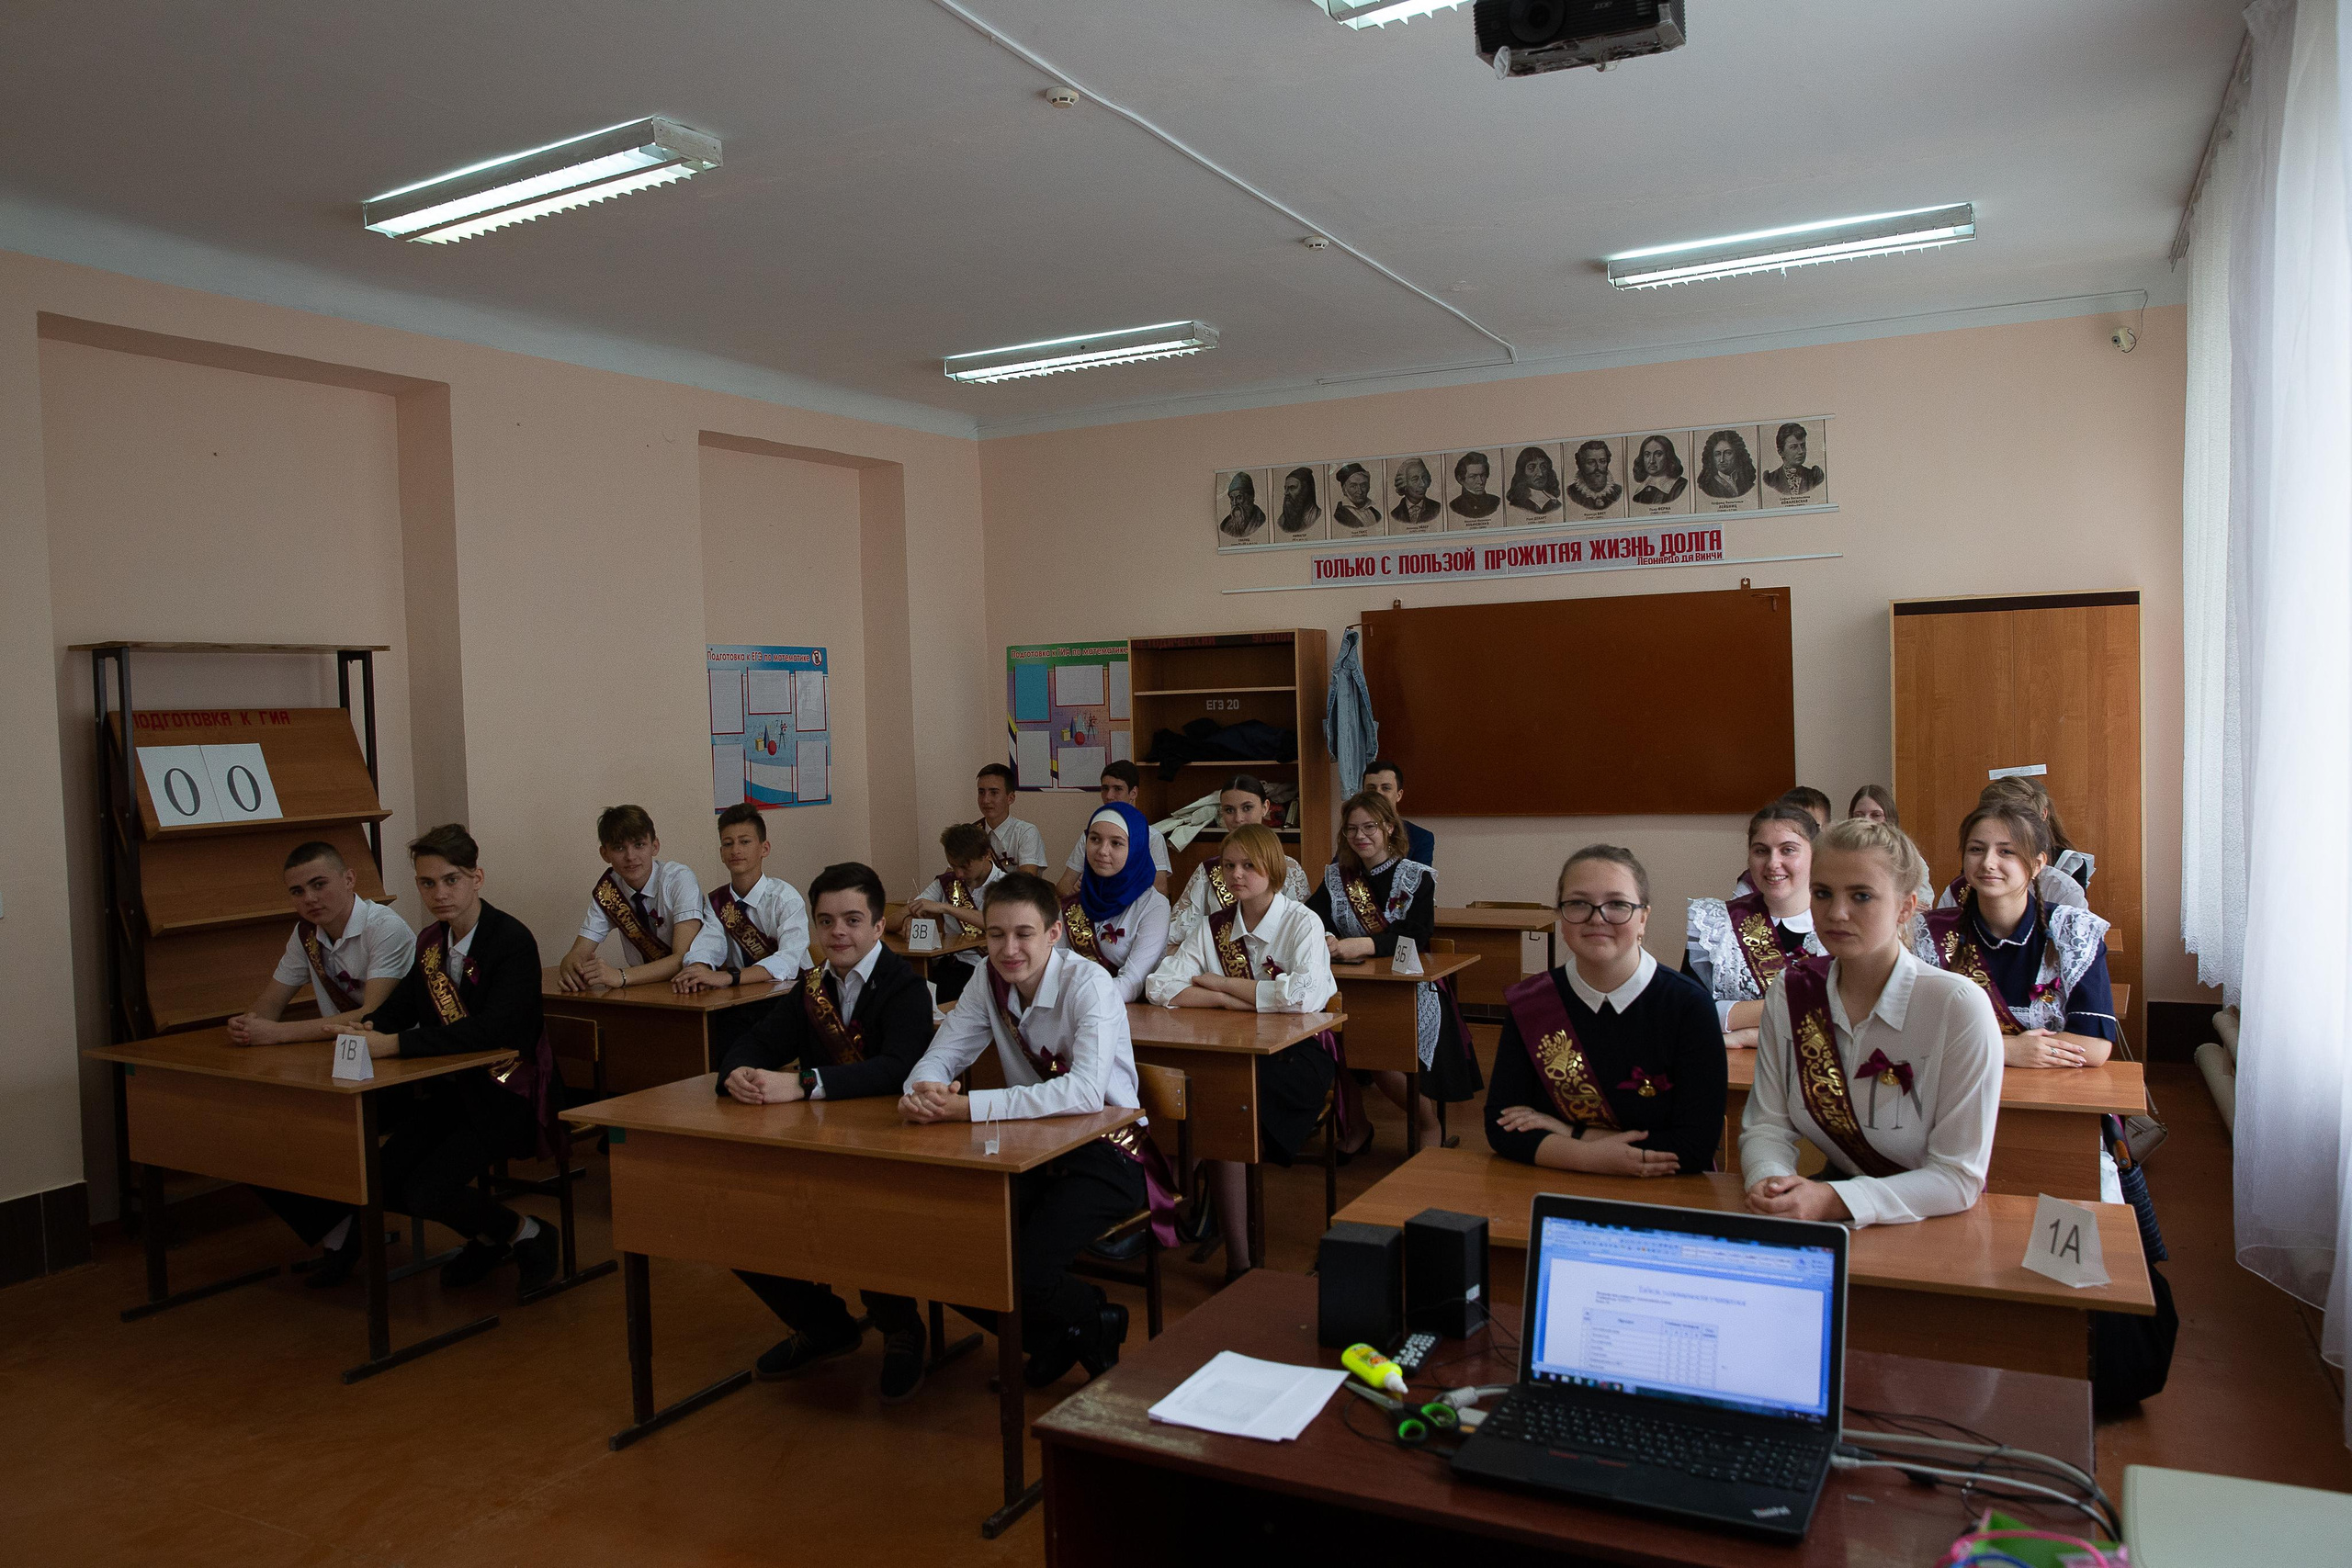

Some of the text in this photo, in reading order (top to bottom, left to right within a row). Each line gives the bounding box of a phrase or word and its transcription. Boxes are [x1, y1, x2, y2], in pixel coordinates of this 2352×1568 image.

[1314, 530, 1722, 579] ТОЛЬКО С ПОЛЬЗОЙ ПРОЖИТАЯ ЖИЗНЬ ДОЛГА
[707, 650, 745, 661] Подготовка
[752, 651, 763, 661] ЕГЭ
[773, 653, 810, 662] математике
[1011, 649, 1050, 659] Подготовка
[1057, 647, 1070, 657] ГИА
[1205, 699, 1240, 711] ЕГЭ 20
[241, 712, 252, 727] К
[259, 710, 291, 726] ГИА
